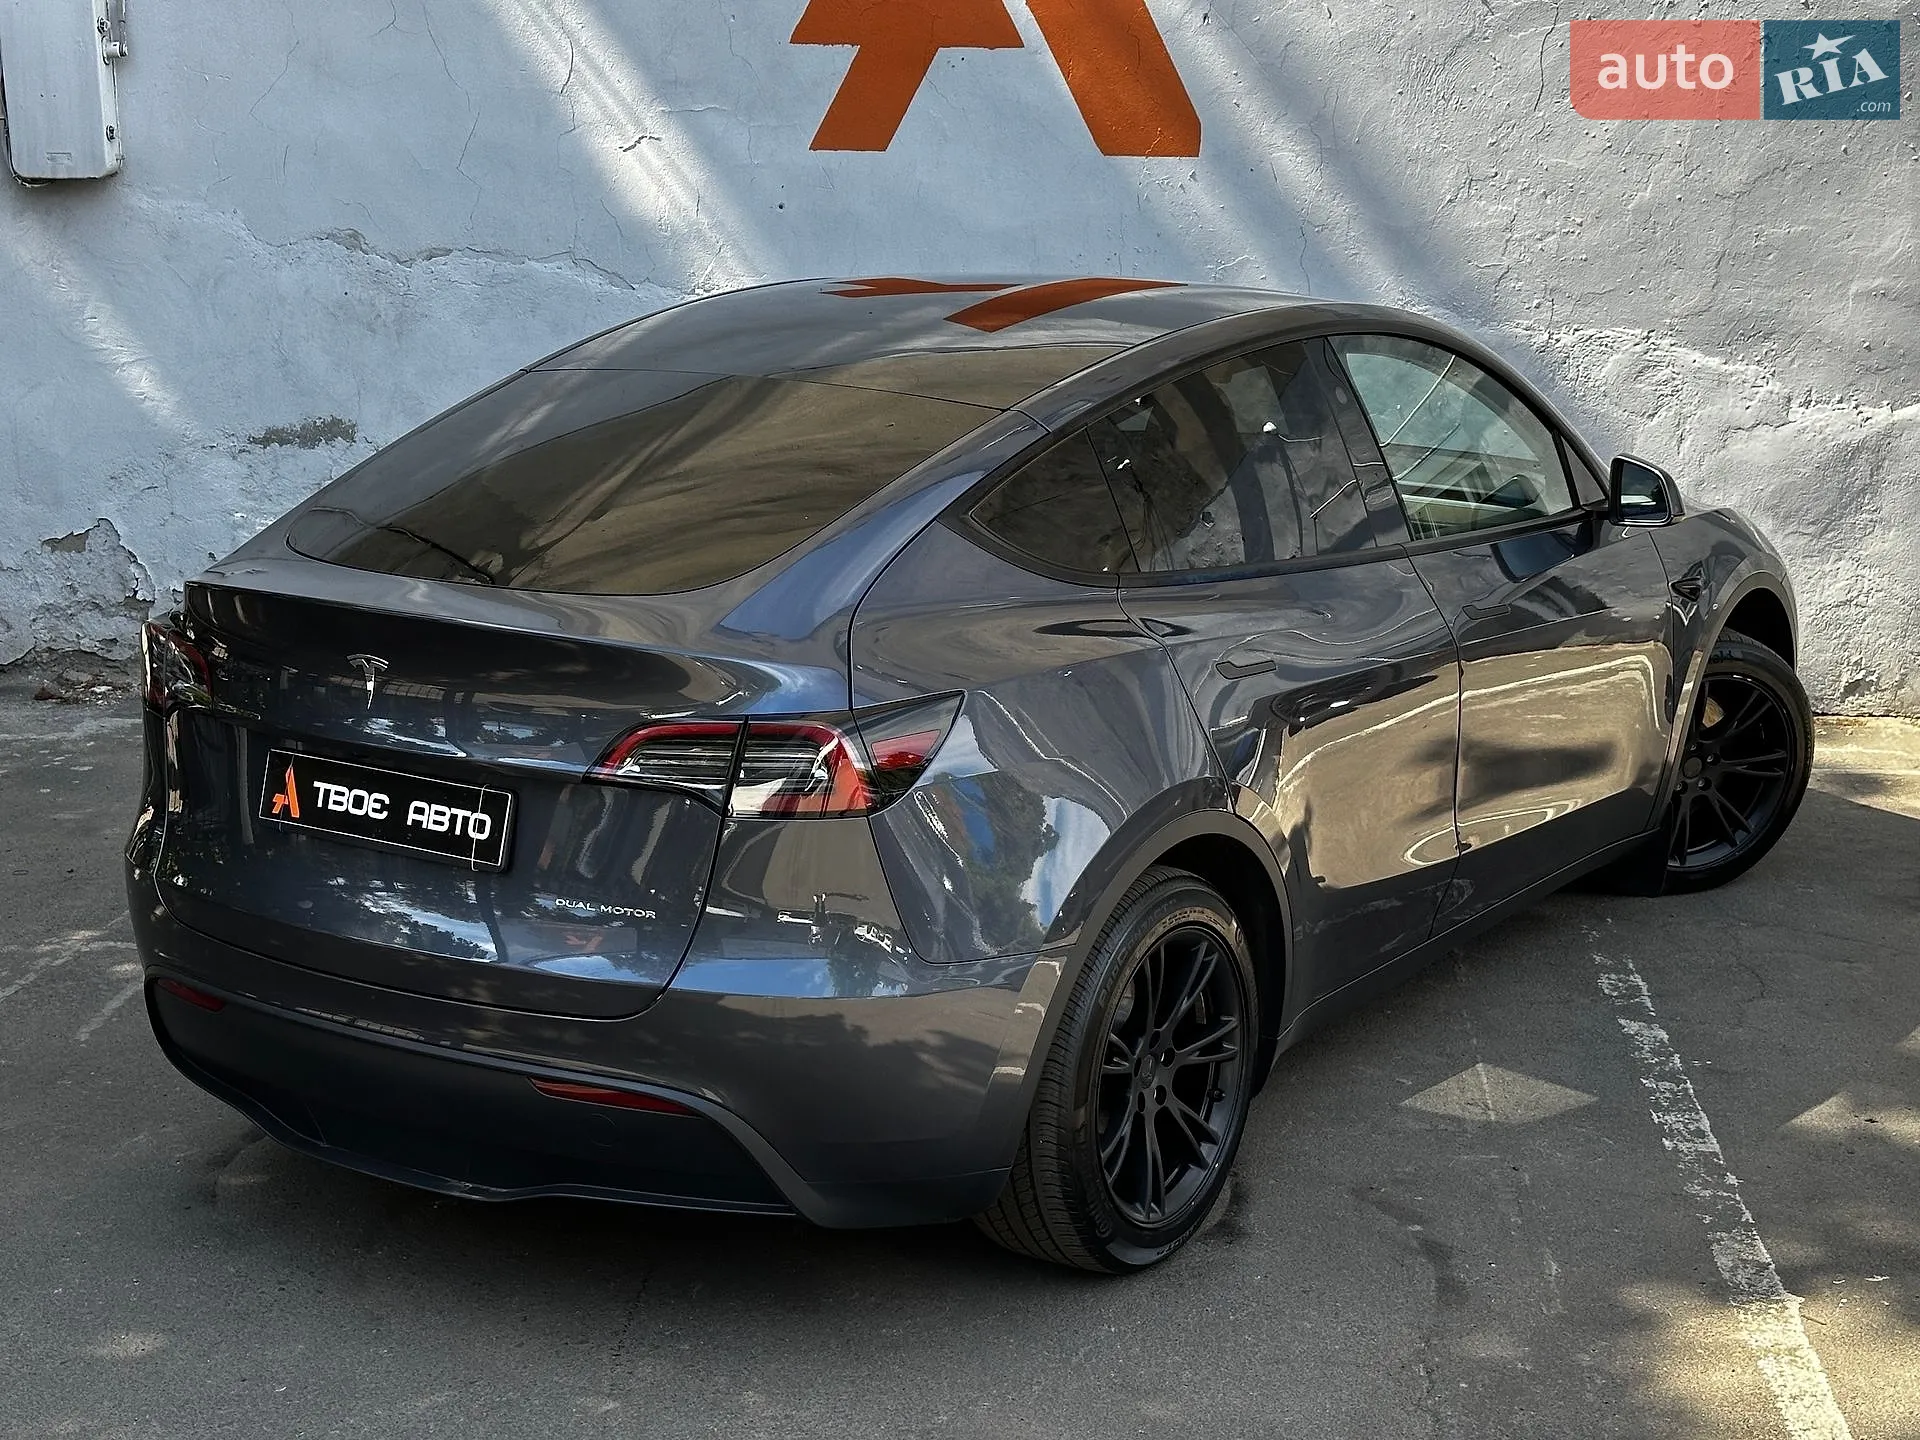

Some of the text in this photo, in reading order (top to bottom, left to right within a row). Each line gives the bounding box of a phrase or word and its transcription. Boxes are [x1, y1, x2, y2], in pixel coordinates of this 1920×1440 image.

[406, 801, 492, 841] АВТО
[555, 898, 656, 919] DUAL MOTOR
